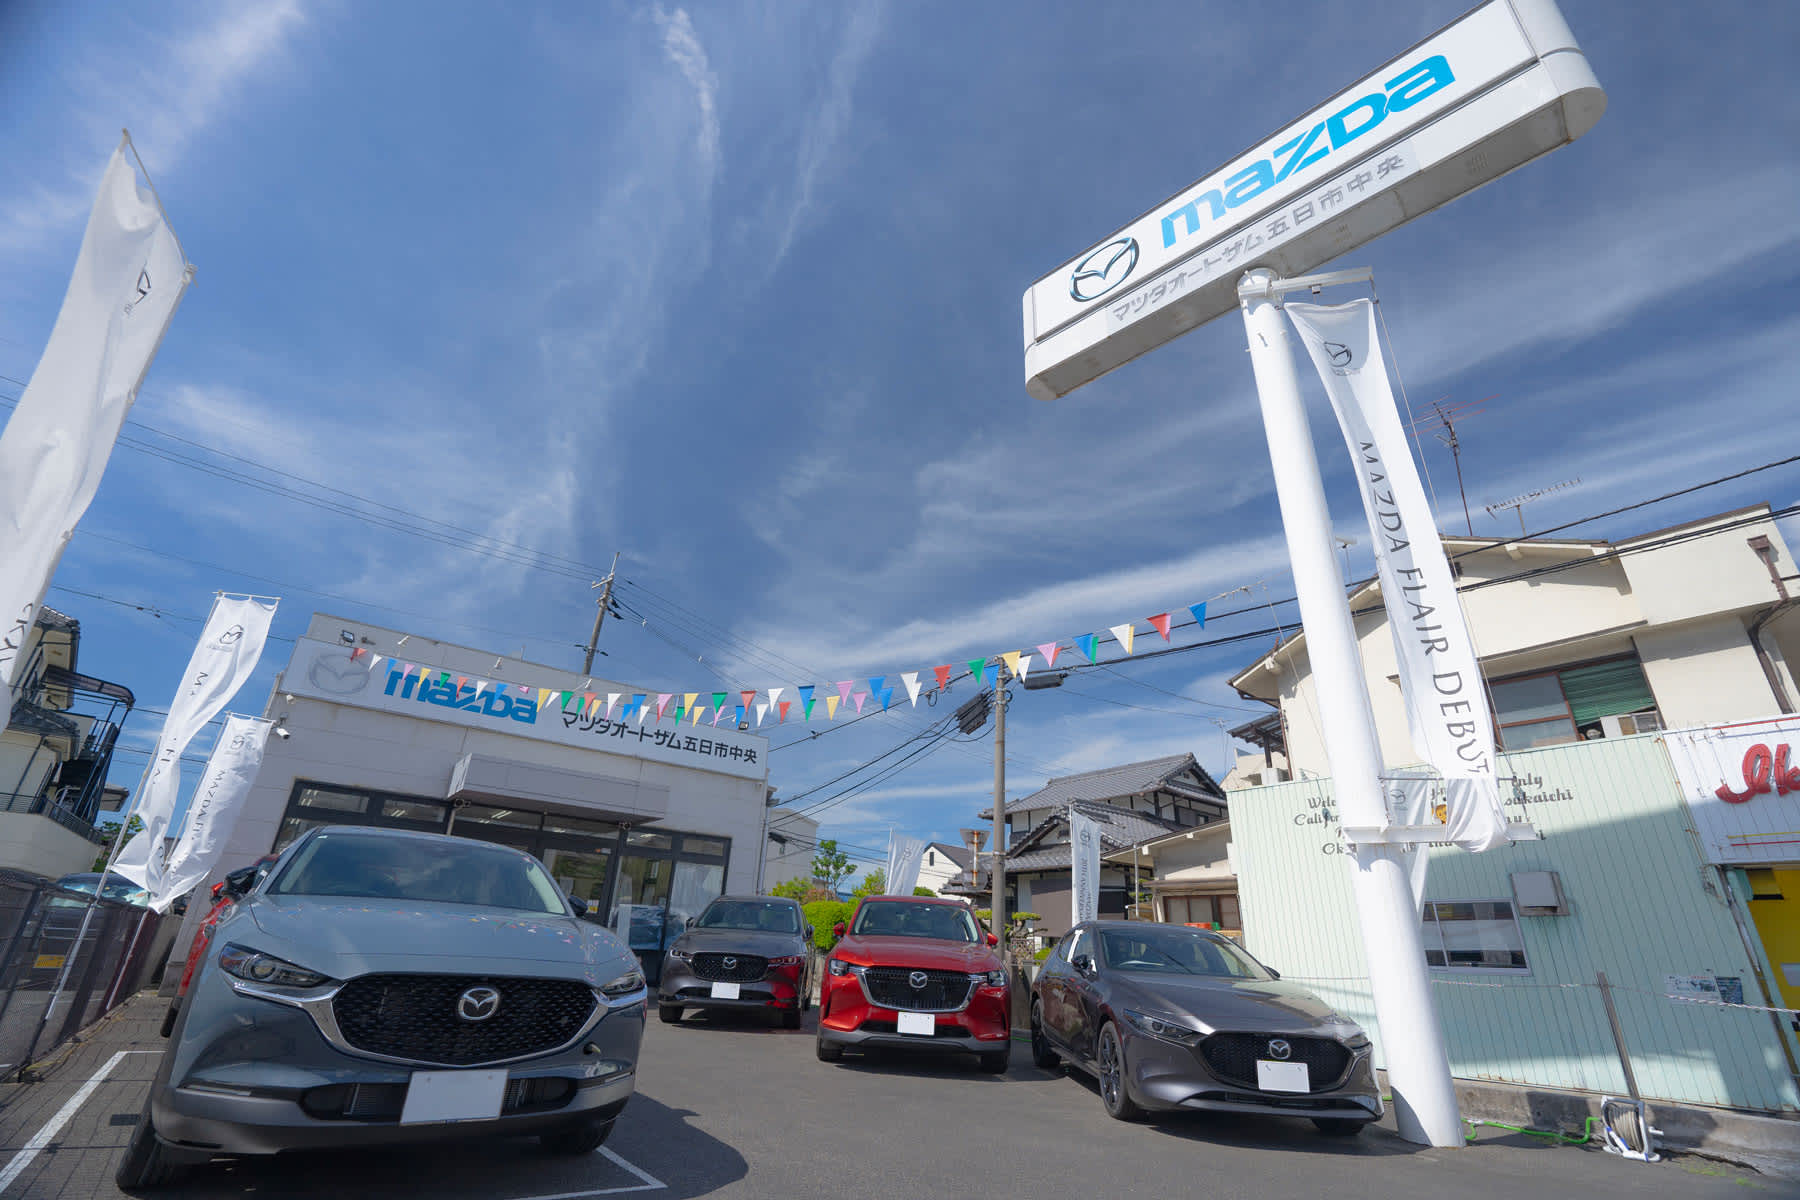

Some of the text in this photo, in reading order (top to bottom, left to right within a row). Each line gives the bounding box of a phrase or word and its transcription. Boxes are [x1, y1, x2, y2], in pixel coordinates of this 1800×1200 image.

[1112, 153, 1405, 322] マツダオートザム五日市中央
[562, 711, 758, 765] マツダオートザム五日市中央
[1396, 567, 1449, 656] FLAIR
[1432, 671, 1490, 774] DEBUT
